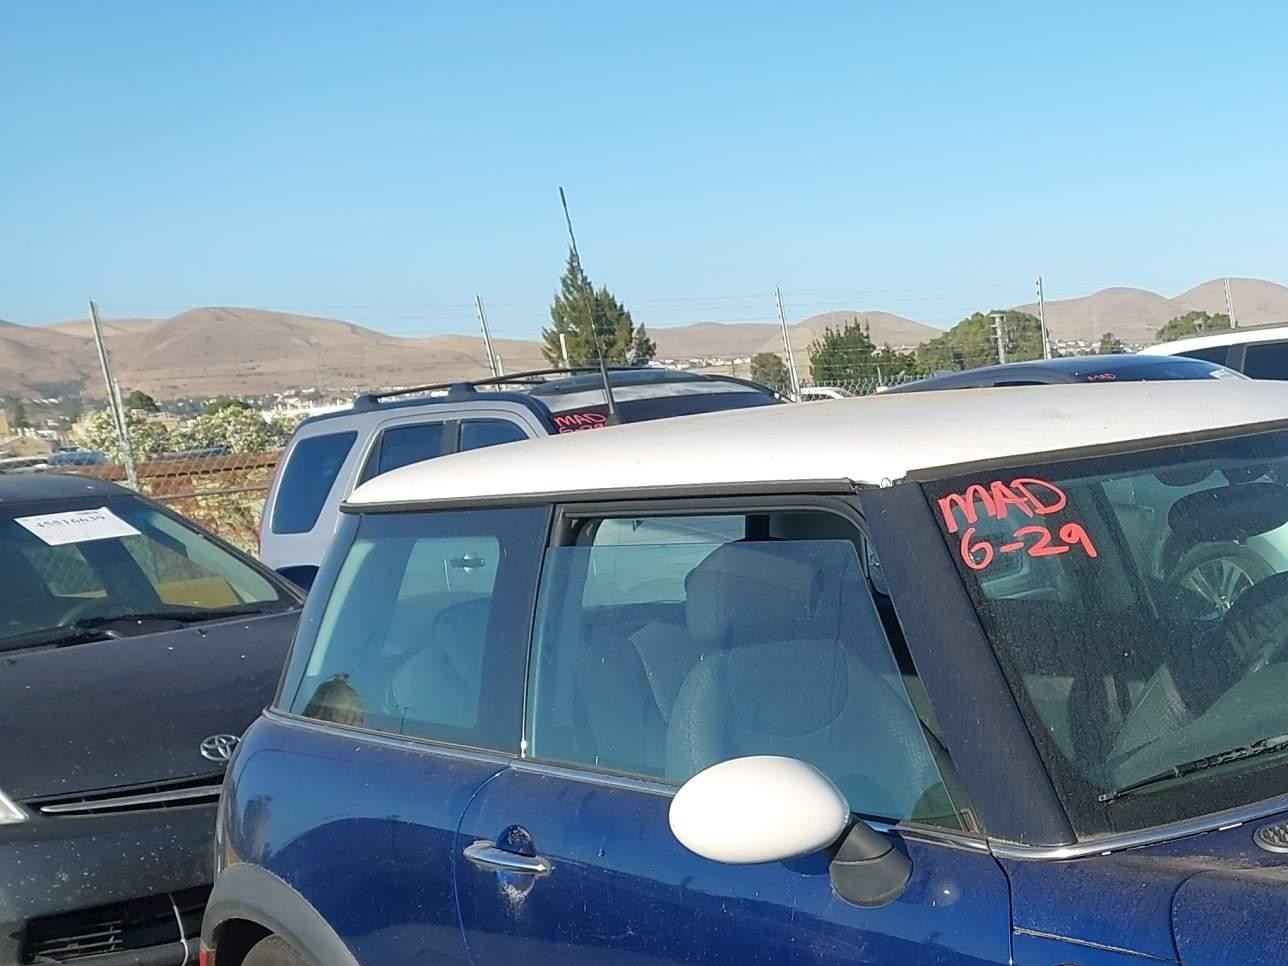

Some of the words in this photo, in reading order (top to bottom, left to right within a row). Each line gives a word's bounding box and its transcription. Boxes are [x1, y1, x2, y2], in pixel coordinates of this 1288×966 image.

[553, 413, 607, 427] MAD
[937, 477, 1067, 534] MAD
[960, 522, 1098, 570] 6-29
